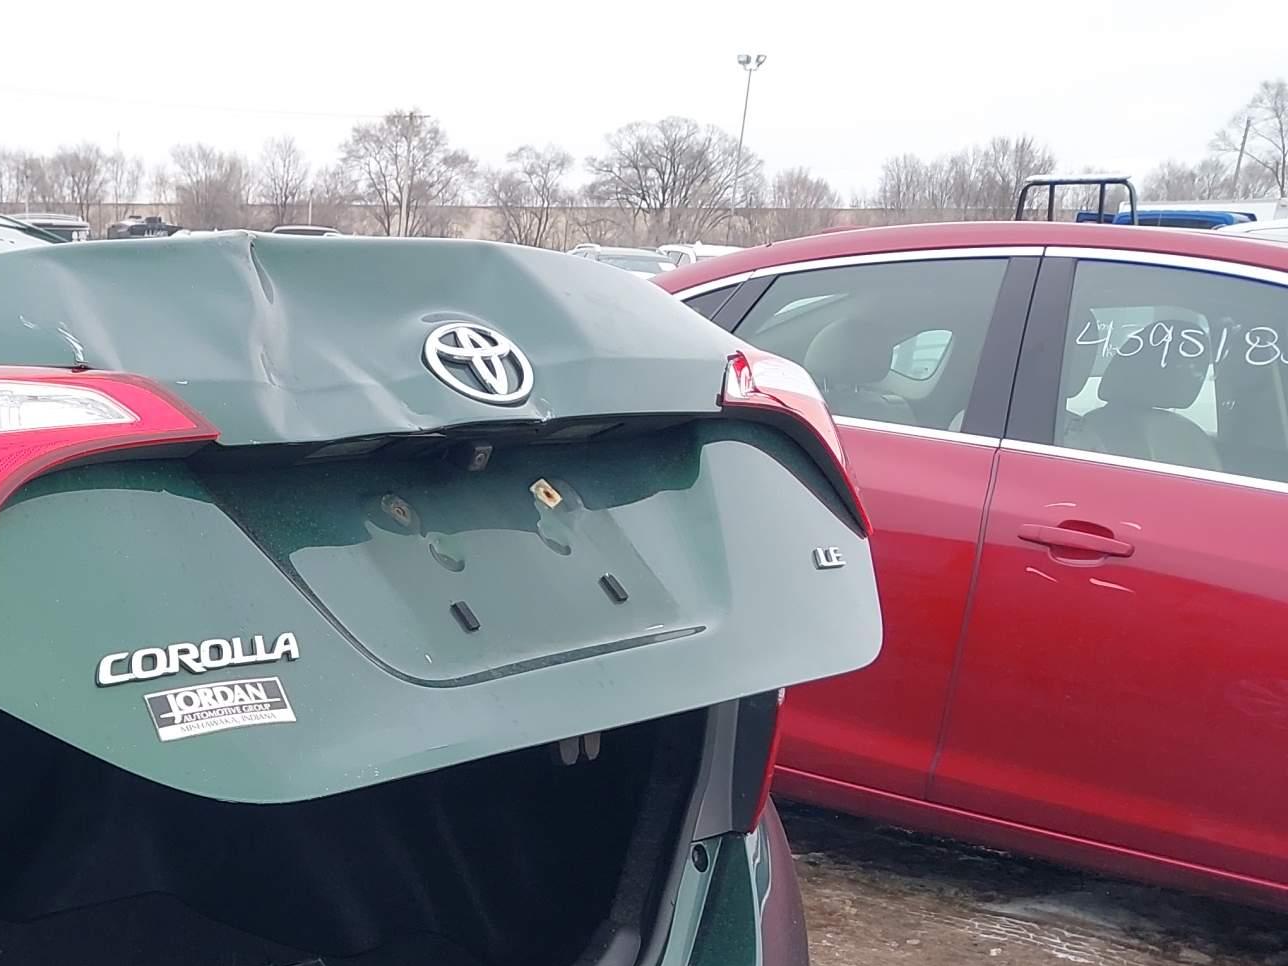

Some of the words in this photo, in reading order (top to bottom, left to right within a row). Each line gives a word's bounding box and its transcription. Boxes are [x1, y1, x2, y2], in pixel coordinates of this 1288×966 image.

[813, 546, 847, 570] LE
[95, 631, 301, 688] COROLLA
[163, 681, 268, 722] JORDAN
[183, 705, 242, 723] AUTOMOTIVE
[242, 702, 272, 714] GROUP
